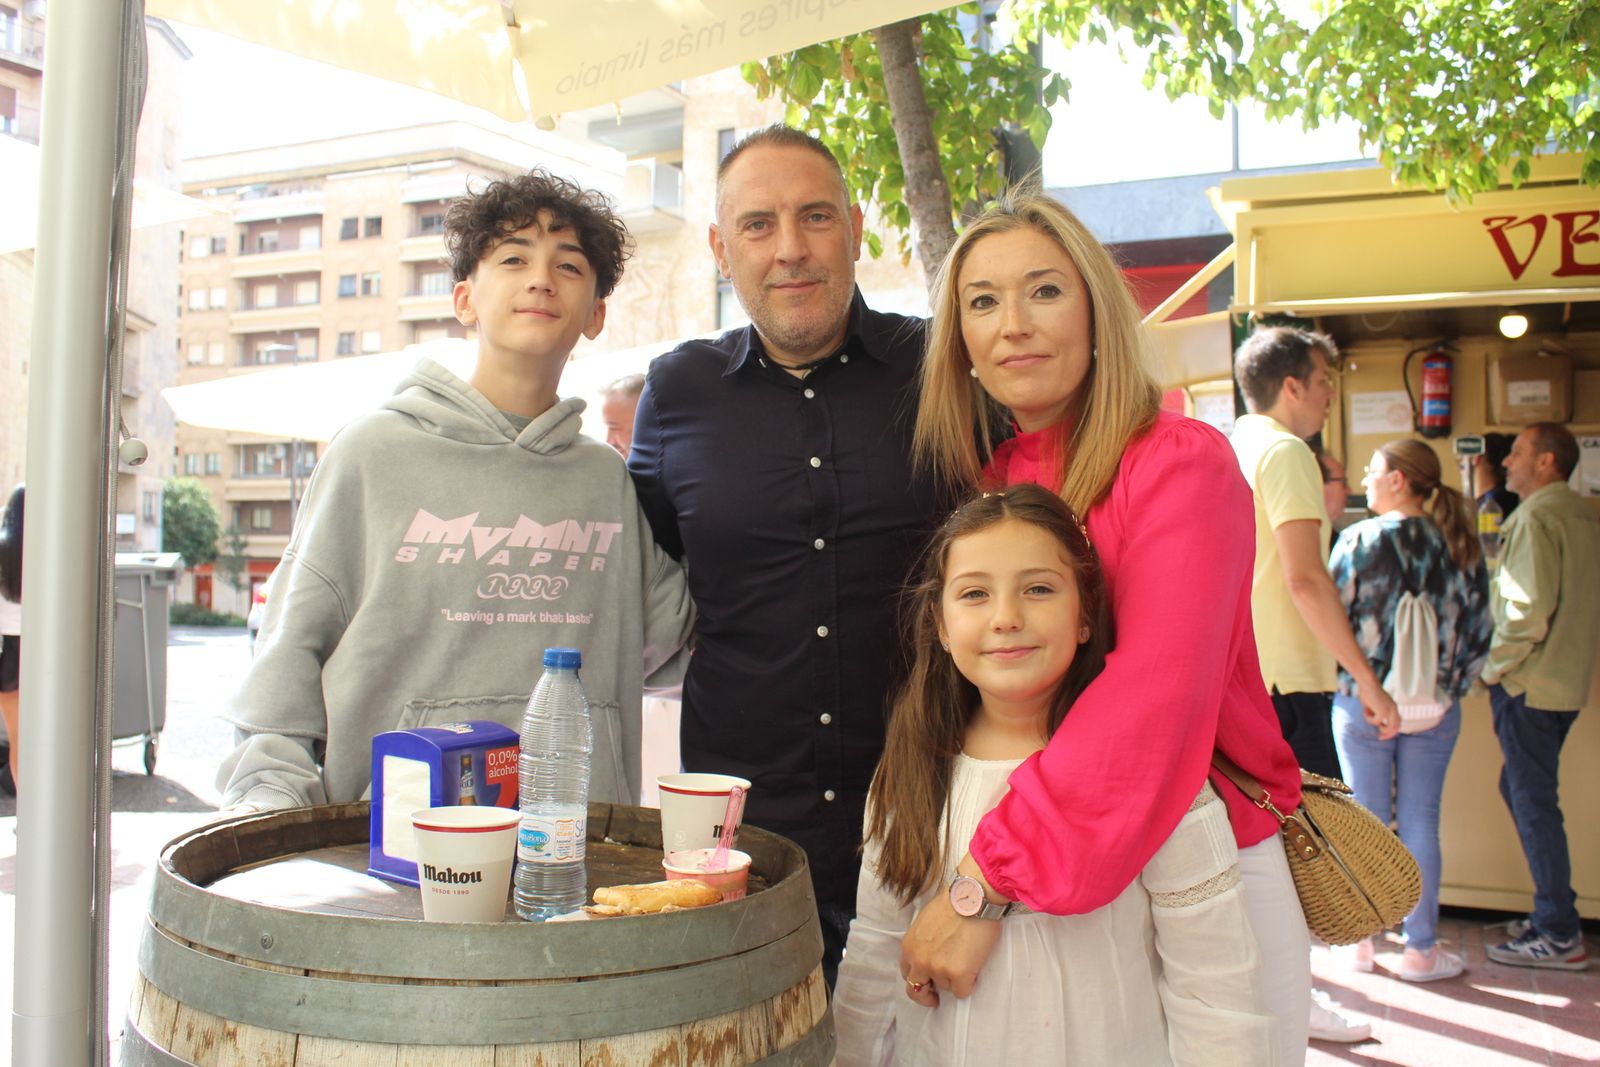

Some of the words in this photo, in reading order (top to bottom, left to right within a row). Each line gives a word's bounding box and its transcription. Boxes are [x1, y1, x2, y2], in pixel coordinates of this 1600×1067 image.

[1482, 210, 1600, 281] VE
[403, 508, 624, 560] MVMNT
[394, 547, 607, 572] SHAPER
[483, 577, 565, 597] 1992
[441, 608, 494, 625] "Leaving
[496, 611, 504, 622] a
[507, 610, 537, 623] mark
[540, 611, 564, 623] that
[488, 749, 518, 766] 0,0%
[488, 763, 518, 779] alcohol
[423, 863, 483, 884] Mahou
[432, 887, 451, 895] DESDE
